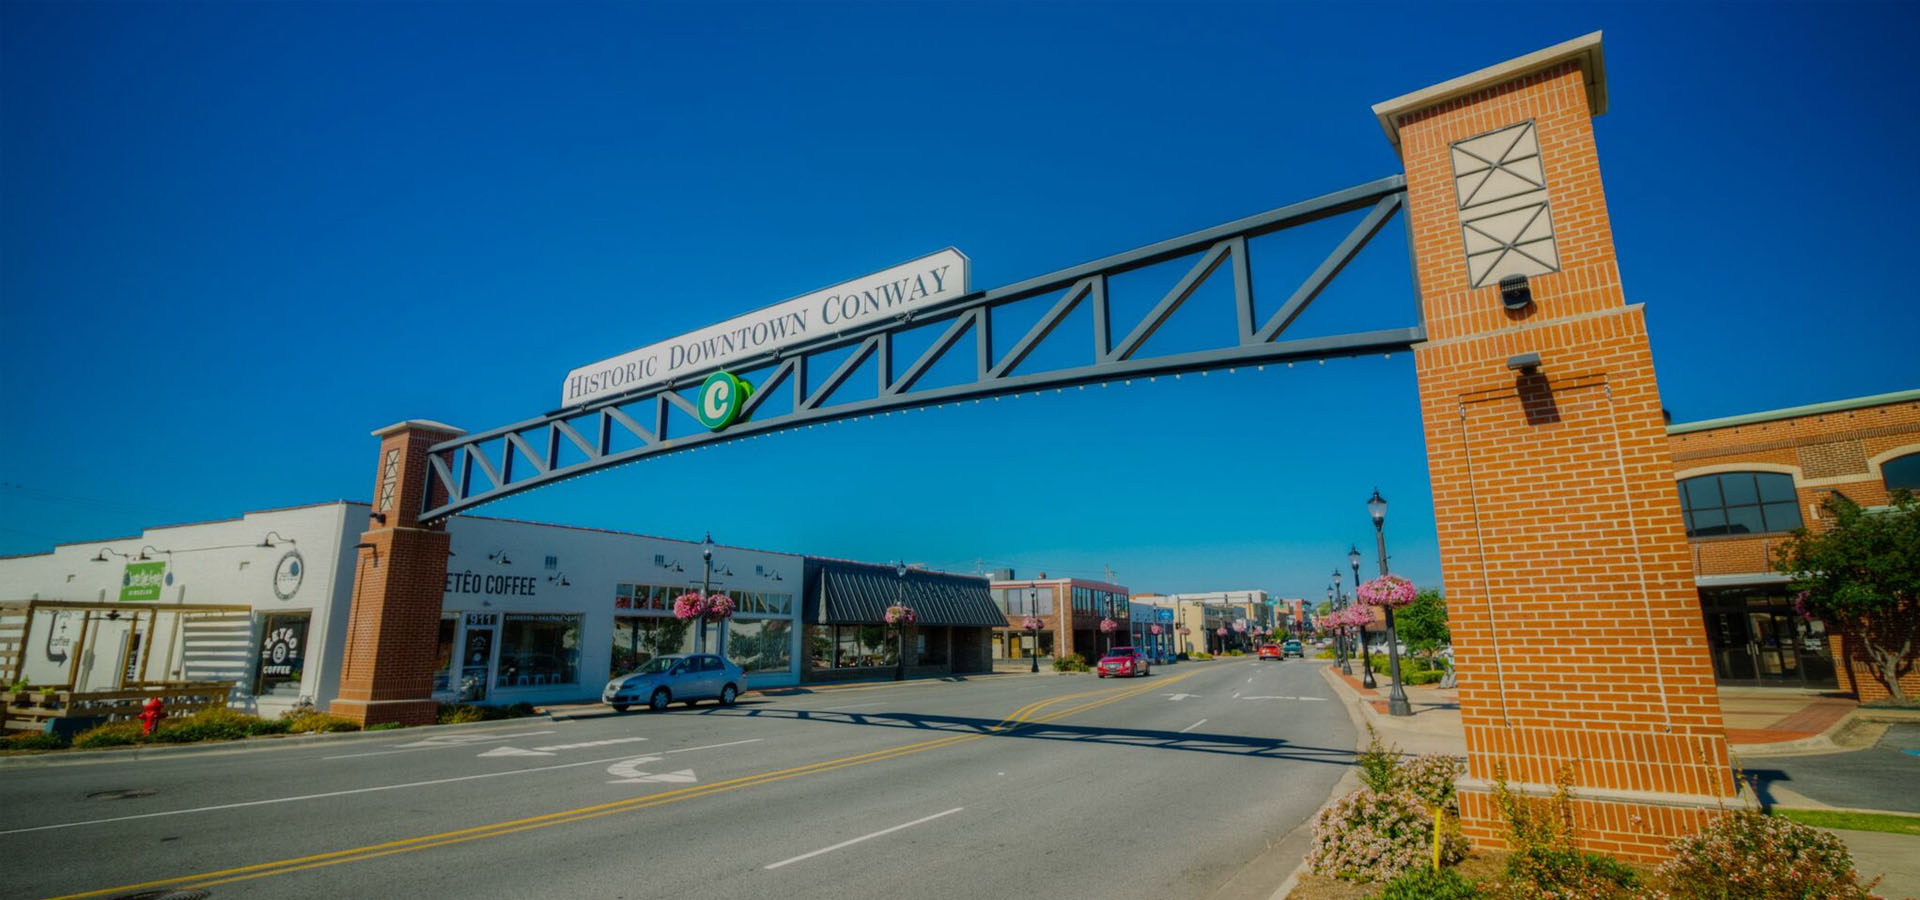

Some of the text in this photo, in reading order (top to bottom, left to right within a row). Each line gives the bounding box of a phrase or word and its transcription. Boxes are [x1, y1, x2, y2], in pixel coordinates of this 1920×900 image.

[569, 264, 950, 399] HISTORIC DOWNTOWN CONWAY
[445, 569, 536, 595] ETÊO COFFEE
[470, 615, 491, 625] 911
[263, 665, 291, 675] COFFEE
